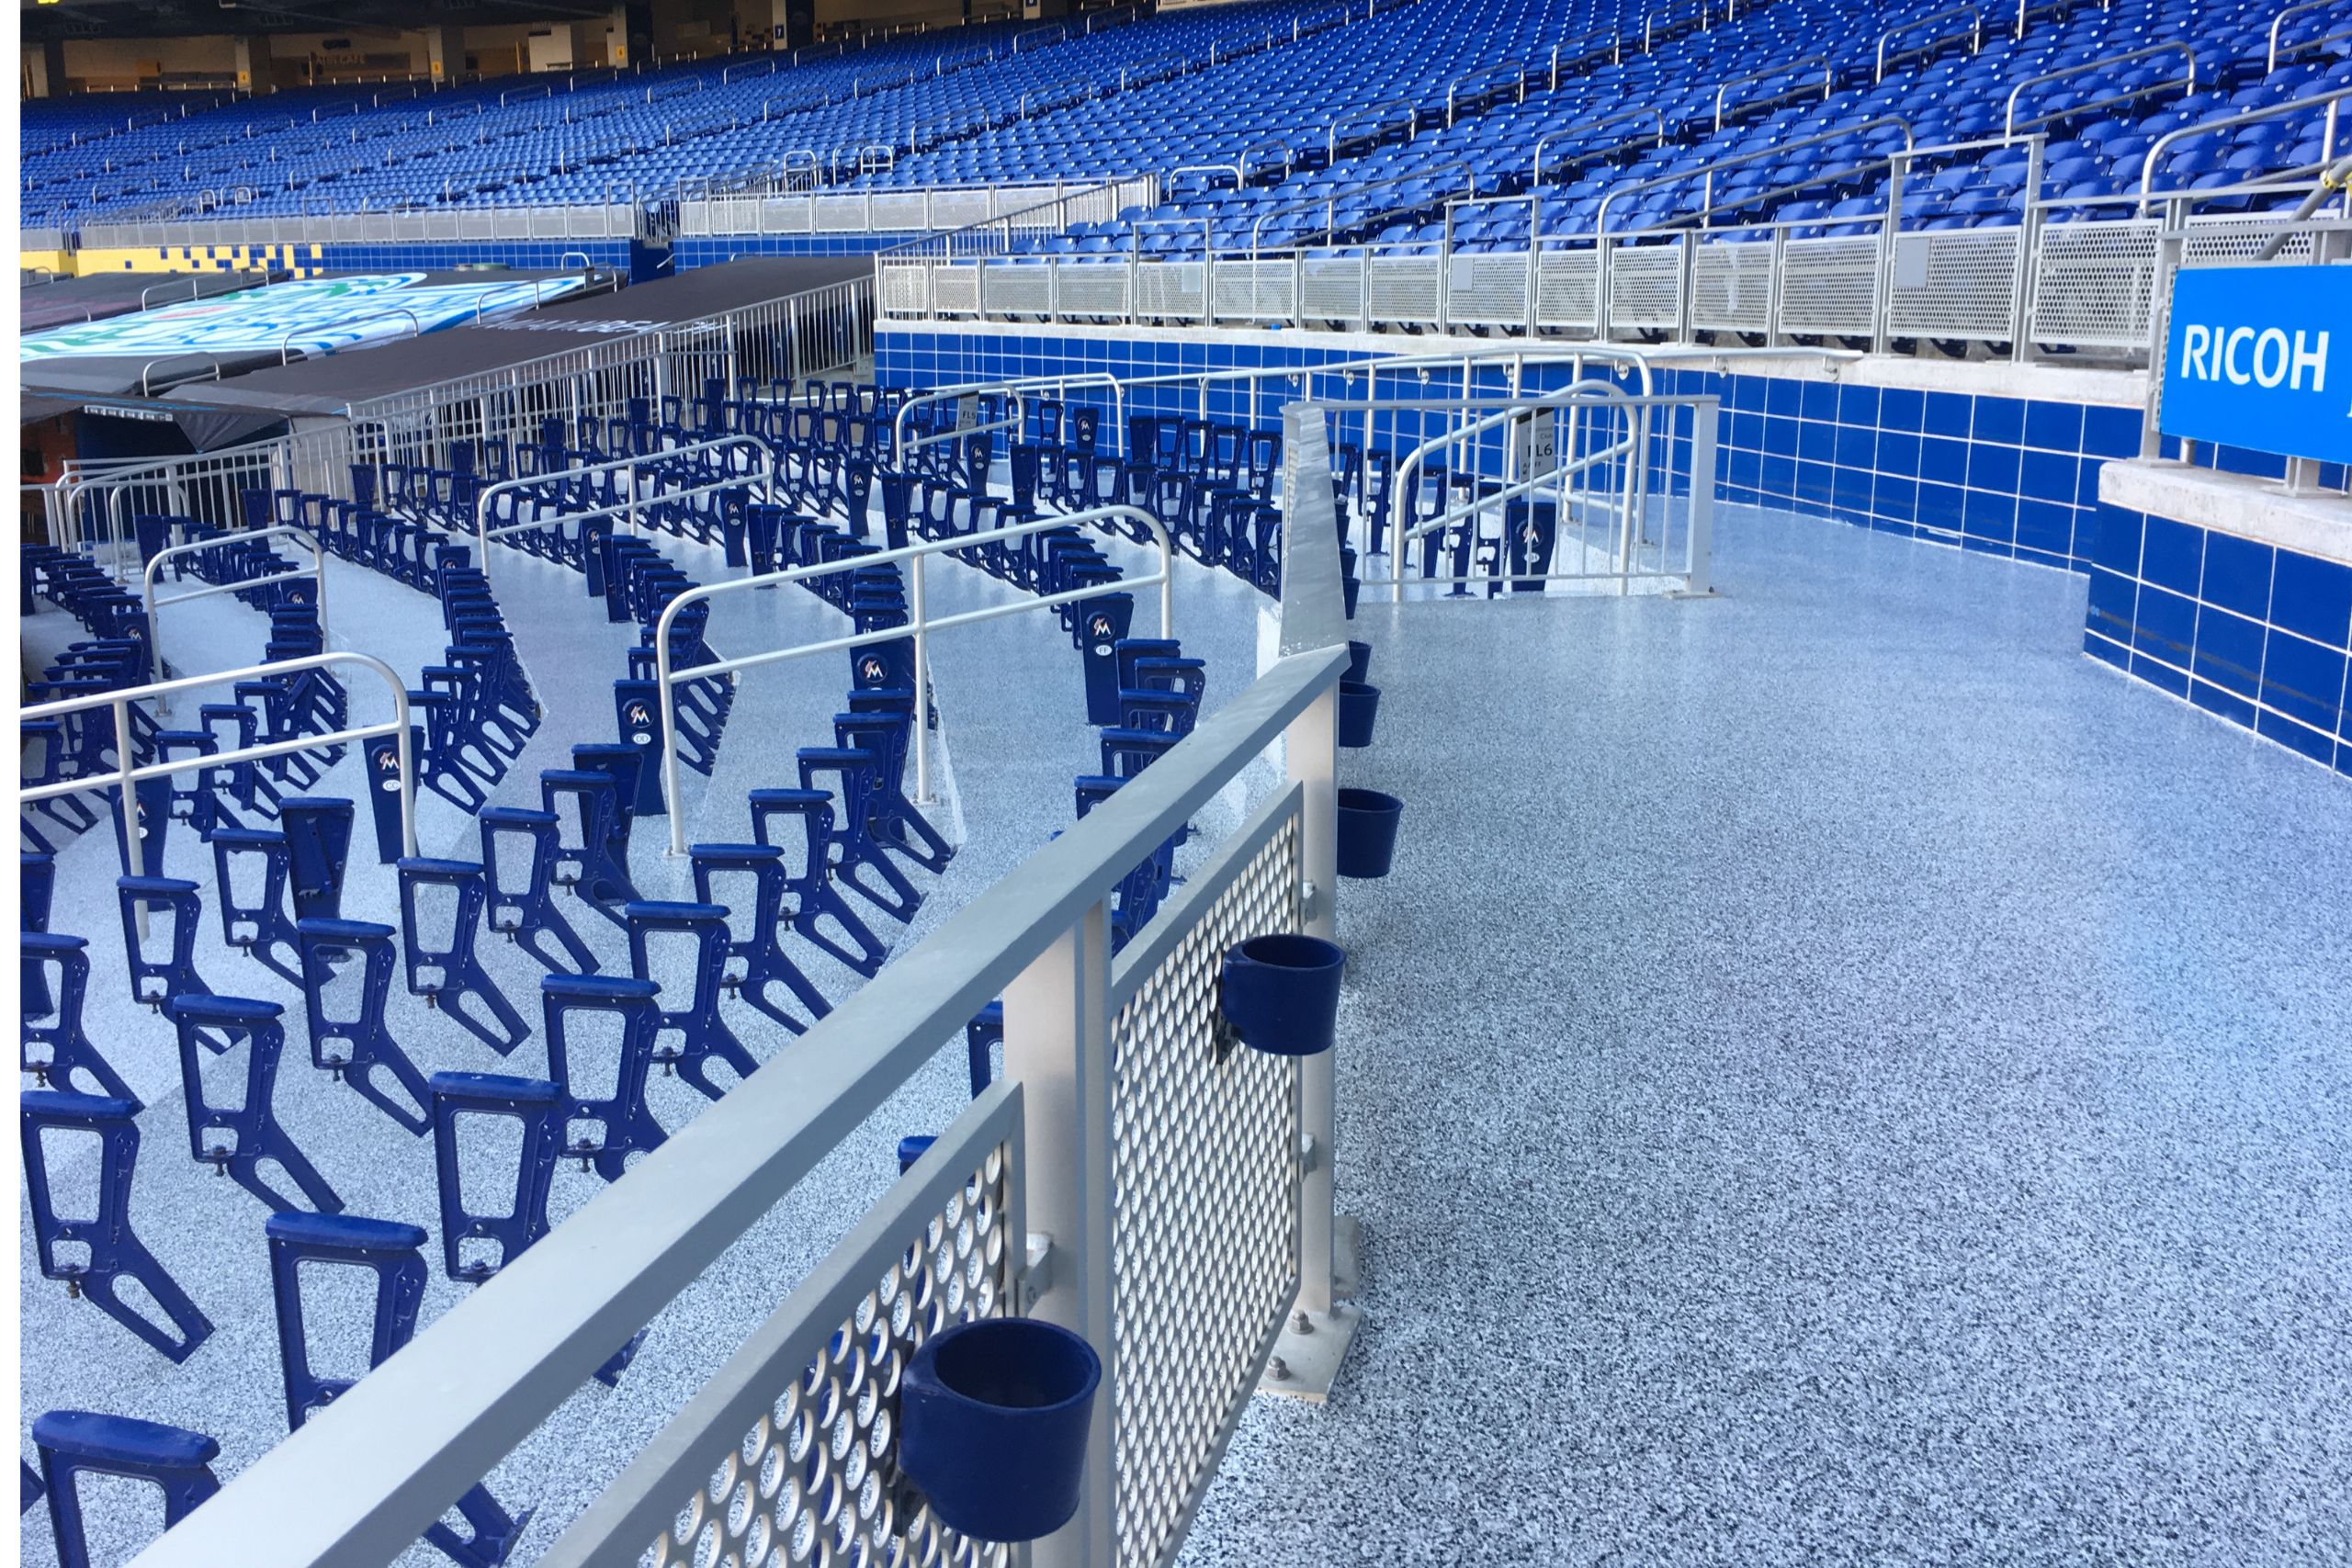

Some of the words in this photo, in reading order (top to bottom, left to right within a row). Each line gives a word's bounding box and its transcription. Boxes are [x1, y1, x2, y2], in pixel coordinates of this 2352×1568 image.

[2180, 324, 2330, 392] RICOH
[962, 410, 976, 420] FL5
[385, 781, 399, 790] CC
